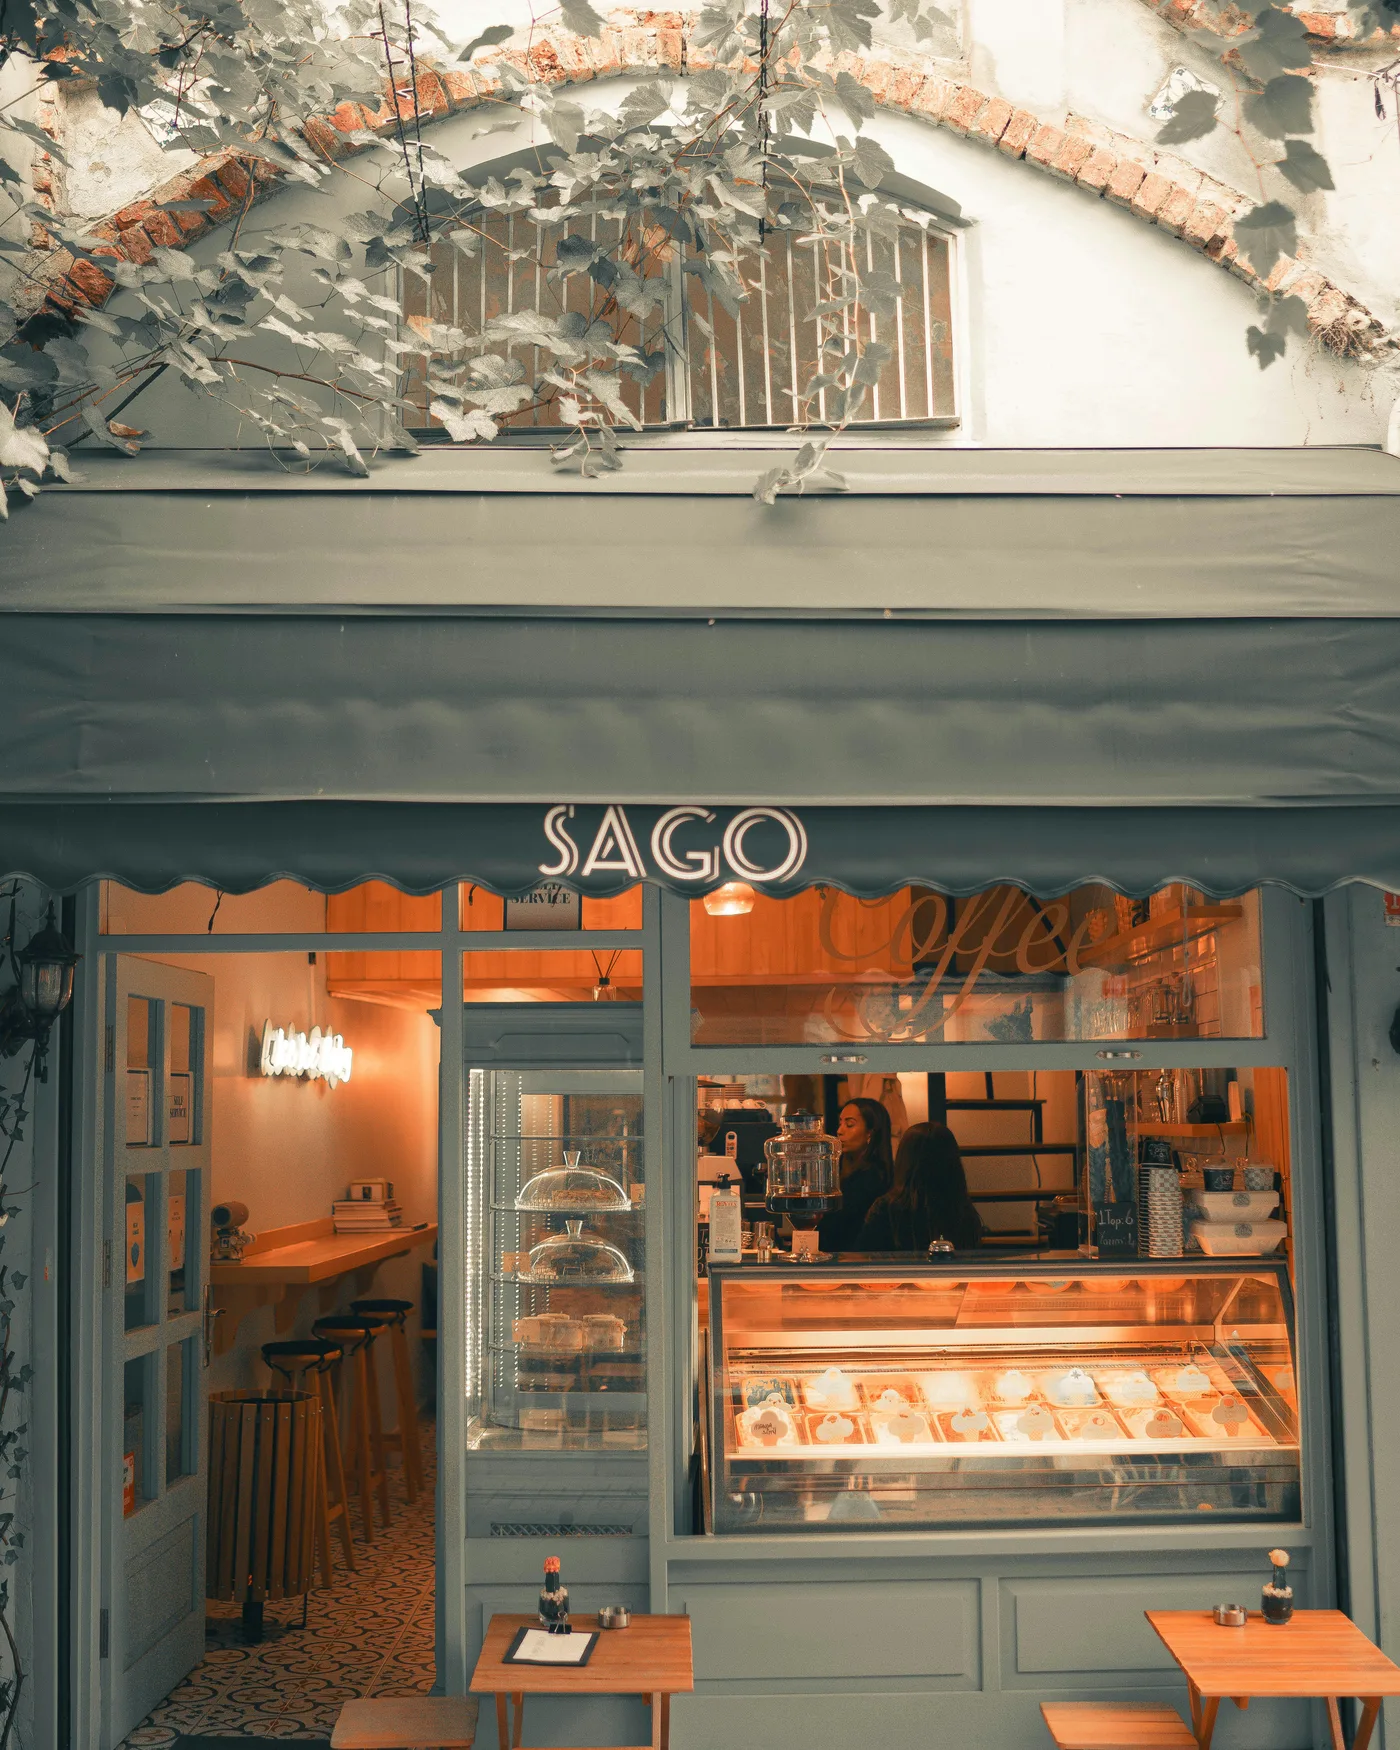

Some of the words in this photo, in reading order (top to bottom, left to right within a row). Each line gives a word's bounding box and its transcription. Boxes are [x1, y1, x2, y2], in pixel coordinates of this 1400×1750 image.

[538, 804, 807, 883] SAGO
[819, 885, 1118, 1041] Coffee
[1125, 1208, 1134, 1225] 6
